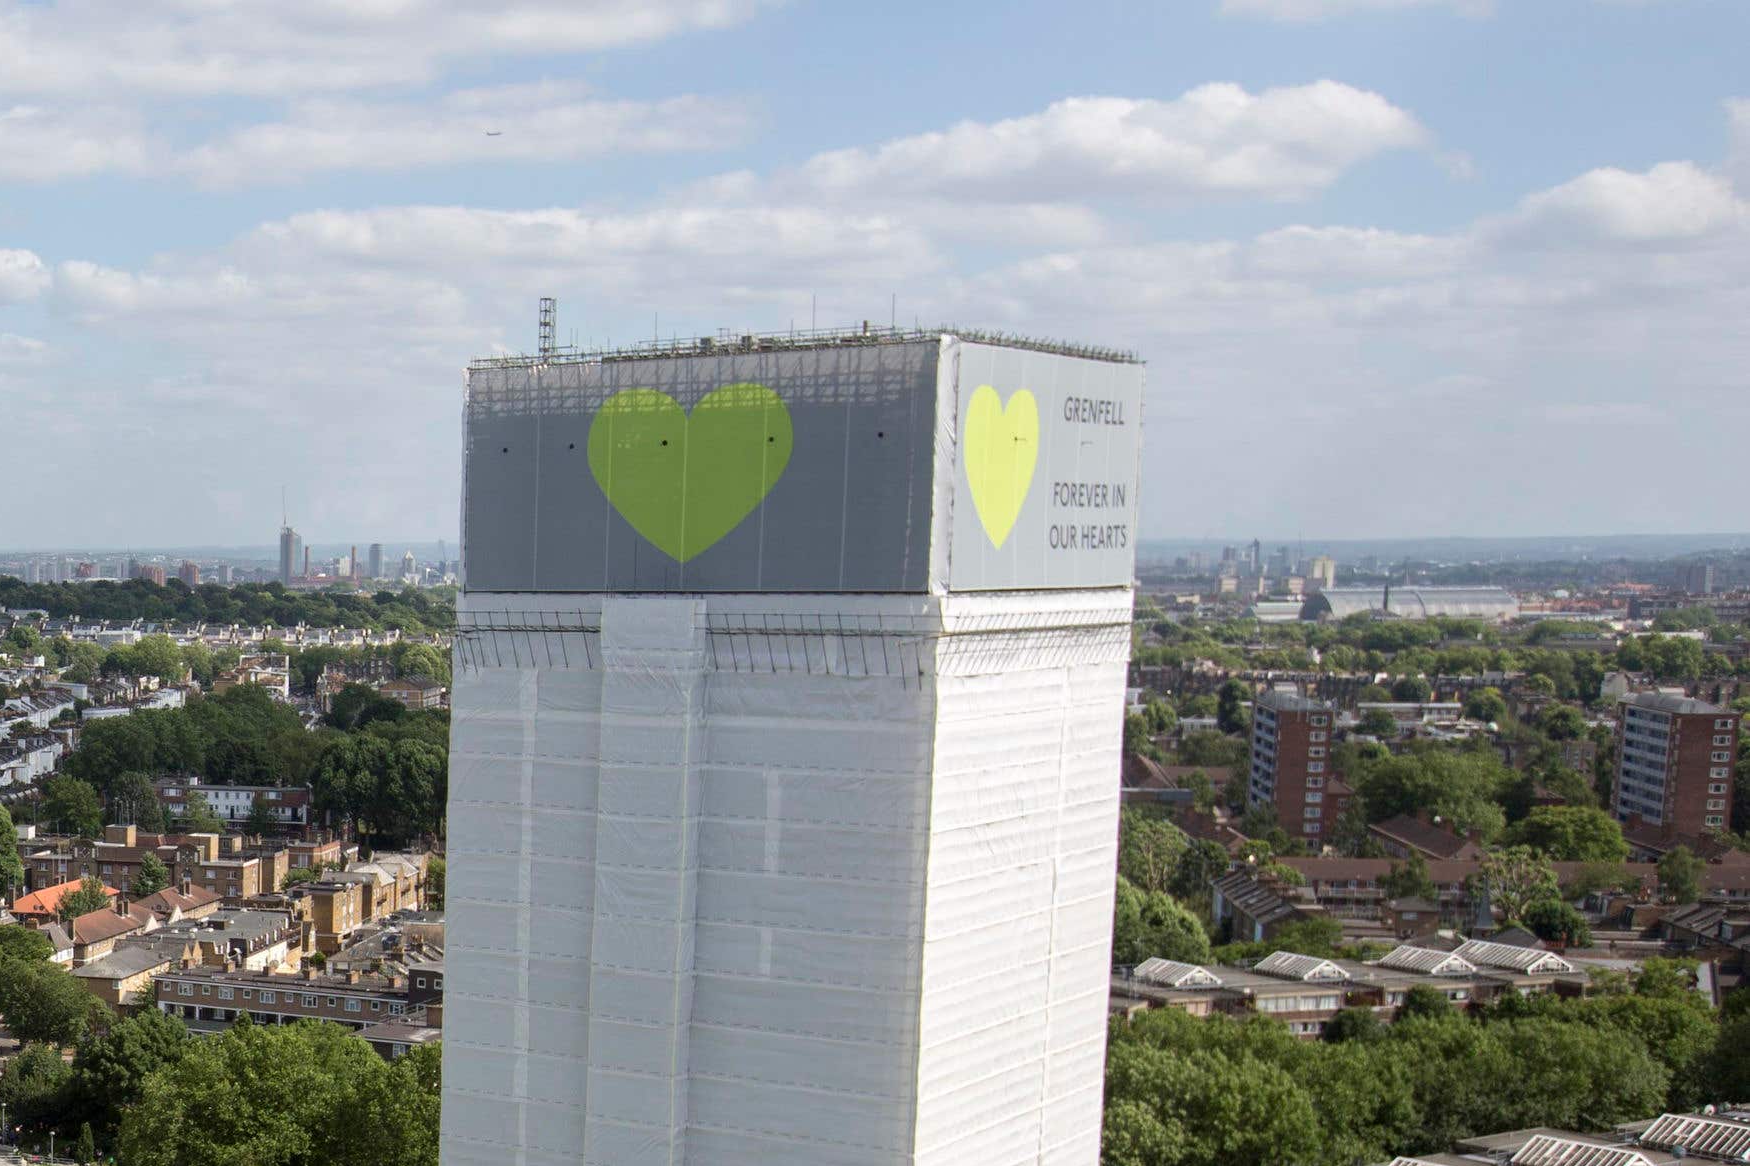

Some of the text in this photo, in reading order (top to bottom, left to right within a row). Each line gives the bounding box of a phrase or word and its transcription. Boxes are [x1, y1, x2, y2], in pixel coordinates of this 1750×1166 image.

[1064, 397, 1124, 425] GRENFELL
[1053, 482, 1126, 508] FOREVER IN
[1049, 525, 1126, 549] OUR HEARTS
